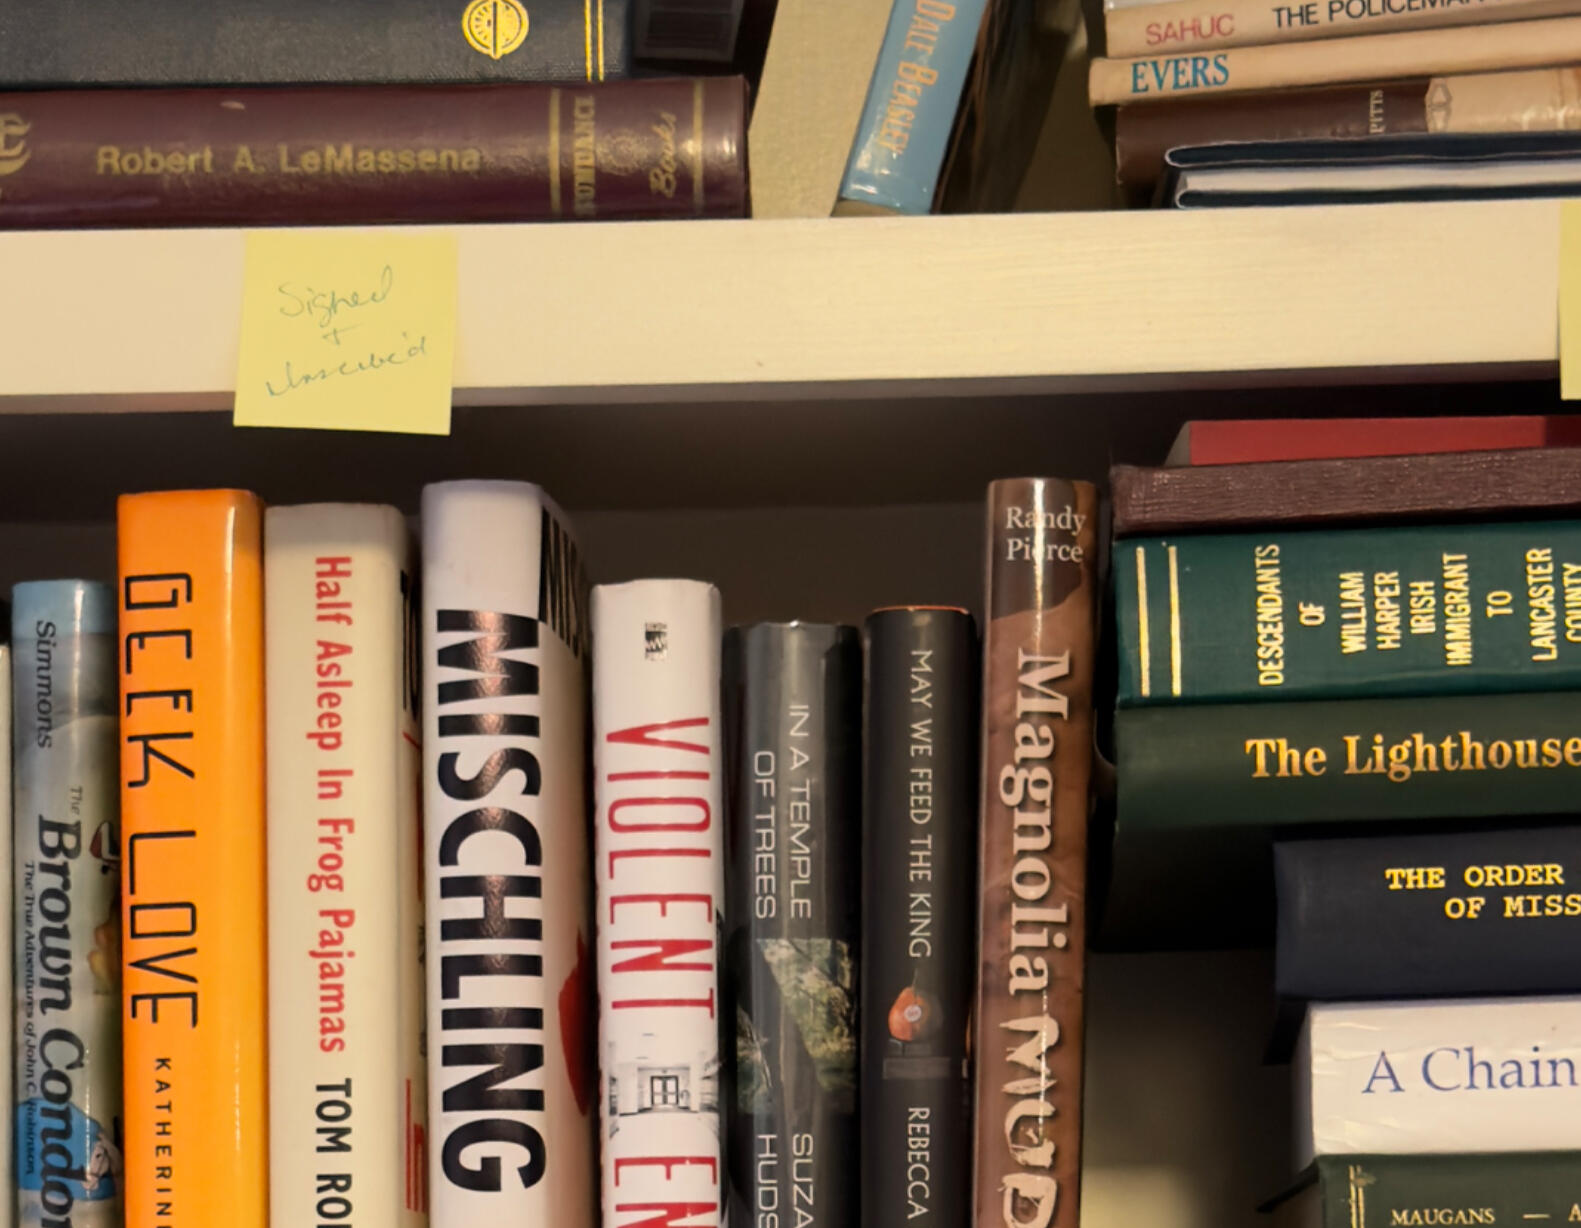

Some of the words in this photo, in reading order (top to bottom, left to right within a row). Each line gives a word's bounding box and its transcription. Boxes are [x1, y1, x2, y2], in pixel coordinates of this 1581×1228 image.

[905, 0, 956, 55] DALE
[1145, 14, 1235, 45] SAHUC
[1273, 4, 1319, 29] THE
[1131, 54, 1230, 94] EVERS
[878, 61, 939, 156] BEASLEY
[1369, 90, 1384, 134] PITTS
[97, 145, 213, 175] Robert
[233, 146, 266, 174] A.
[279, 144, 481, 174] LeMassena
[278, 265, 393, 328] Signed
[1006, 506, 1087, 537] Randy
[1006, 538, 1084, 562] Pierce
[315, 556, 352, 626] Half
[1255, 543, 1284, 687] DESCENDANTS
[1299, 601, 1326, 628] OF
[1339, 571, 1368, 655] WILLIAM
[1374, 570, 1402, 651] HARPER
[1409, 580, 1437, 635] IRISH
[1442, 552, 1473, 667] IMMIGRANT
[1486, 590, 1514, 619] TO
[1525, 547, 1558, 662] LANCASTER
[1562, 562, 1581, 643] COUNTY
[36, 620, 56, 750] Simmons
[125, 573, 195, 788] GEEK
[306, 639, 353, 751] Asleep
[911, 649, 934, 710] MAY
[789, 704, 809, 737] IN
[911, 718, 933, 758] WE
[318, 769, 354, 800] In
[754, 750, 775, 798] OF
[789, 746, 810, 771] A
[1245, 738, 1327, 778] The
[1343, 730, 1581, 782] Lighthouse
[910, 767, 932, 826] FEED
[1000, 646, 1071, 996] Magnolia
[24, 862, 35, 890] The
[308, 818, 355, 893] Frog
[606, 716, 715, 1019] VIOLENT
[755, 808, 776, 920] TREES
[790, 780, 812, 920] TEMPLE
[910, 834, 932, 884] THE
[1385, 867, 1446, 890] THE
[1464, 863, 1565, 887] ORDER
[38, 814, 82, 1016] Brown
[129, 830, 199, 1028] LOVE
[436, 609, 546, 1193] MISCHLING
[909, 892, 932, 960] KING
[1444, 897, 1486, 920] OF
[1503, 894, 1581, 918] MISS
[308, 908, 356, 1054] Pajamas
[1361, 1050, 1405, 1094] A
[1421, 1045, 1580, 1093] Chain
[316, 1077, 352, 1153] TOM
[907, 1107, 931, 1220] REBECCA
[1391, 1207, 1496, 1226] MAUGANS
